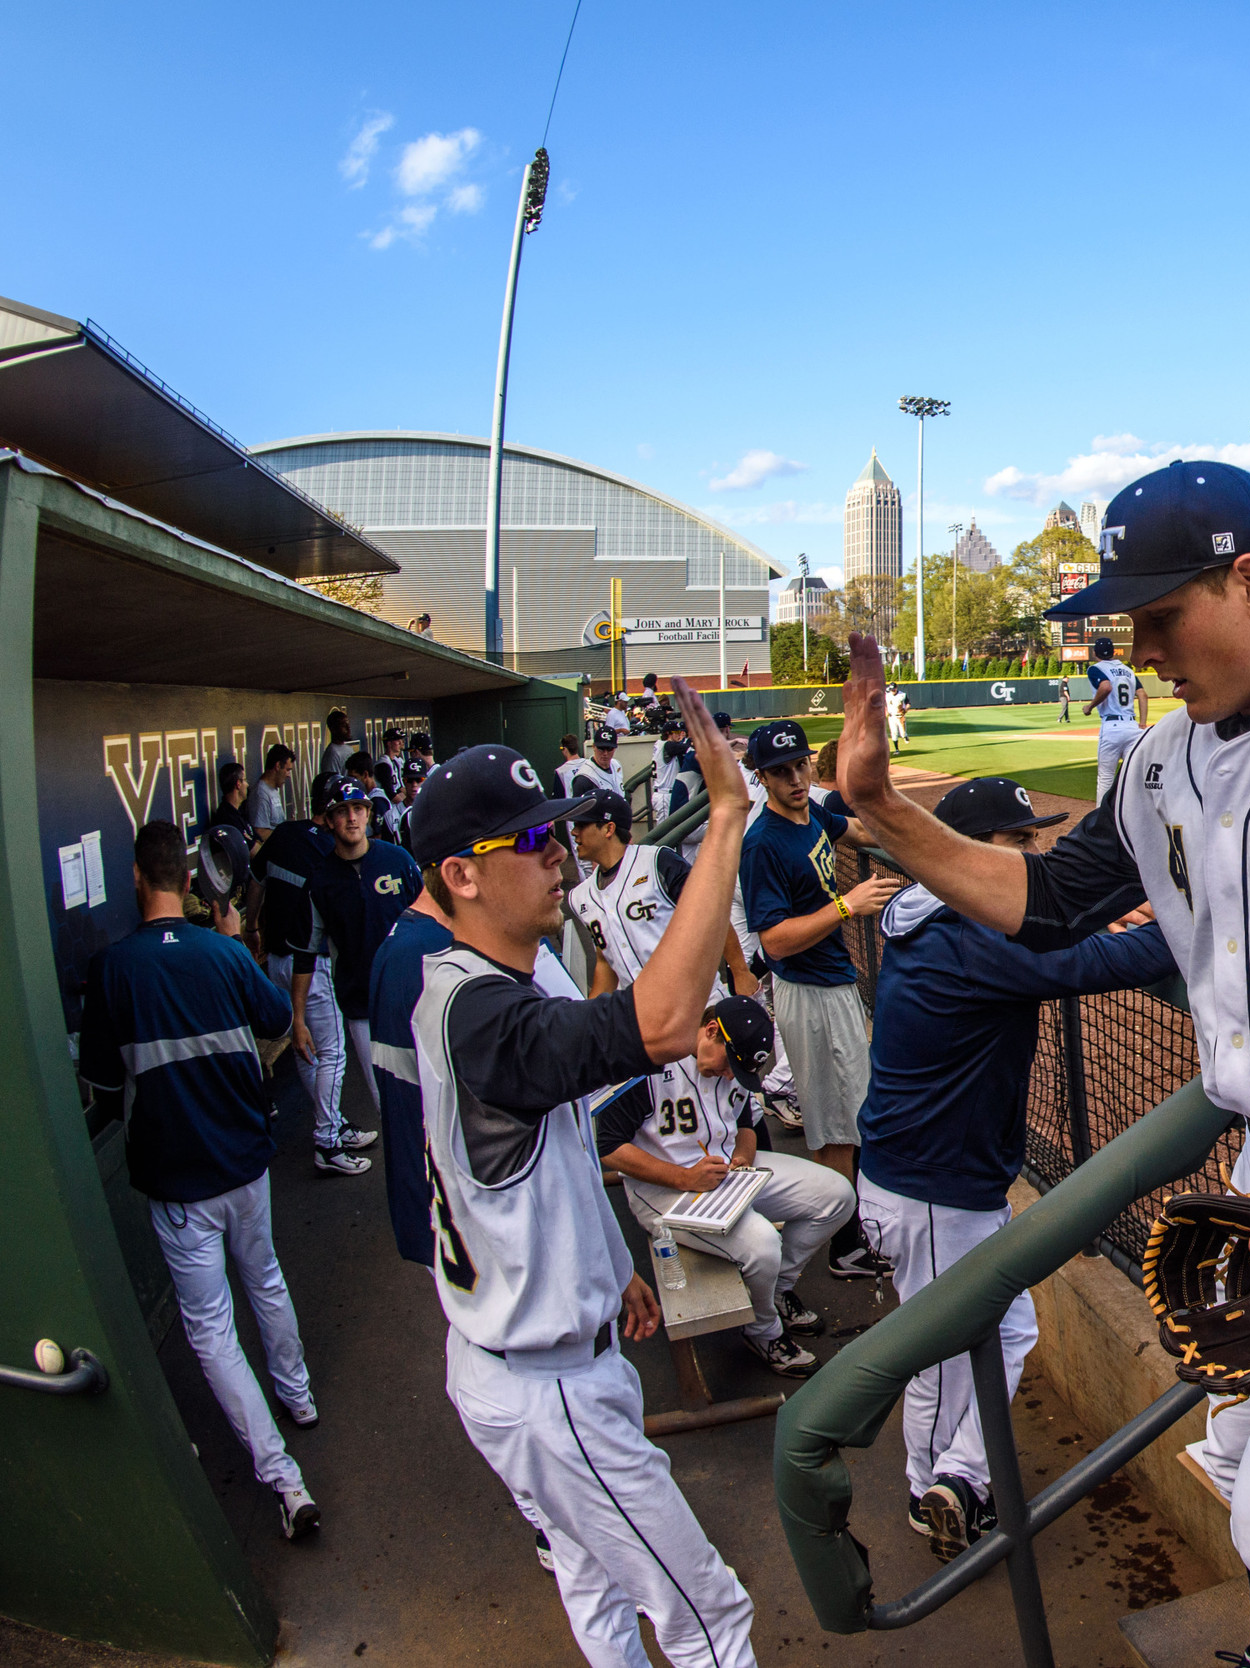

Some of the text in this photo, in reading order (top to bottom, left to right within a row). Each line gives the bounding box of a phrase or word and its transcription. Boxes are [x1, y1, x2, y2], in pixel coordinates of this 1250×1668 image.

[634, 618, 662, 629] JOHN
[664, 619, 682, 628] and
[685, 617, 714, 628] MARY
[658, 630, 729, 642] Football Facili
[990, 681, 1016, 701] GT
[1117, 683, 1129, 706] 6
[772, 731, 797, 748] GT
[103, 721, 322, 880] YEOW
[374, 874, 402, 895] GT
[625, 900, 657, 921] GT
[586, 919, 607, 950] 8
[658, 1097, 698, 1137] 39
